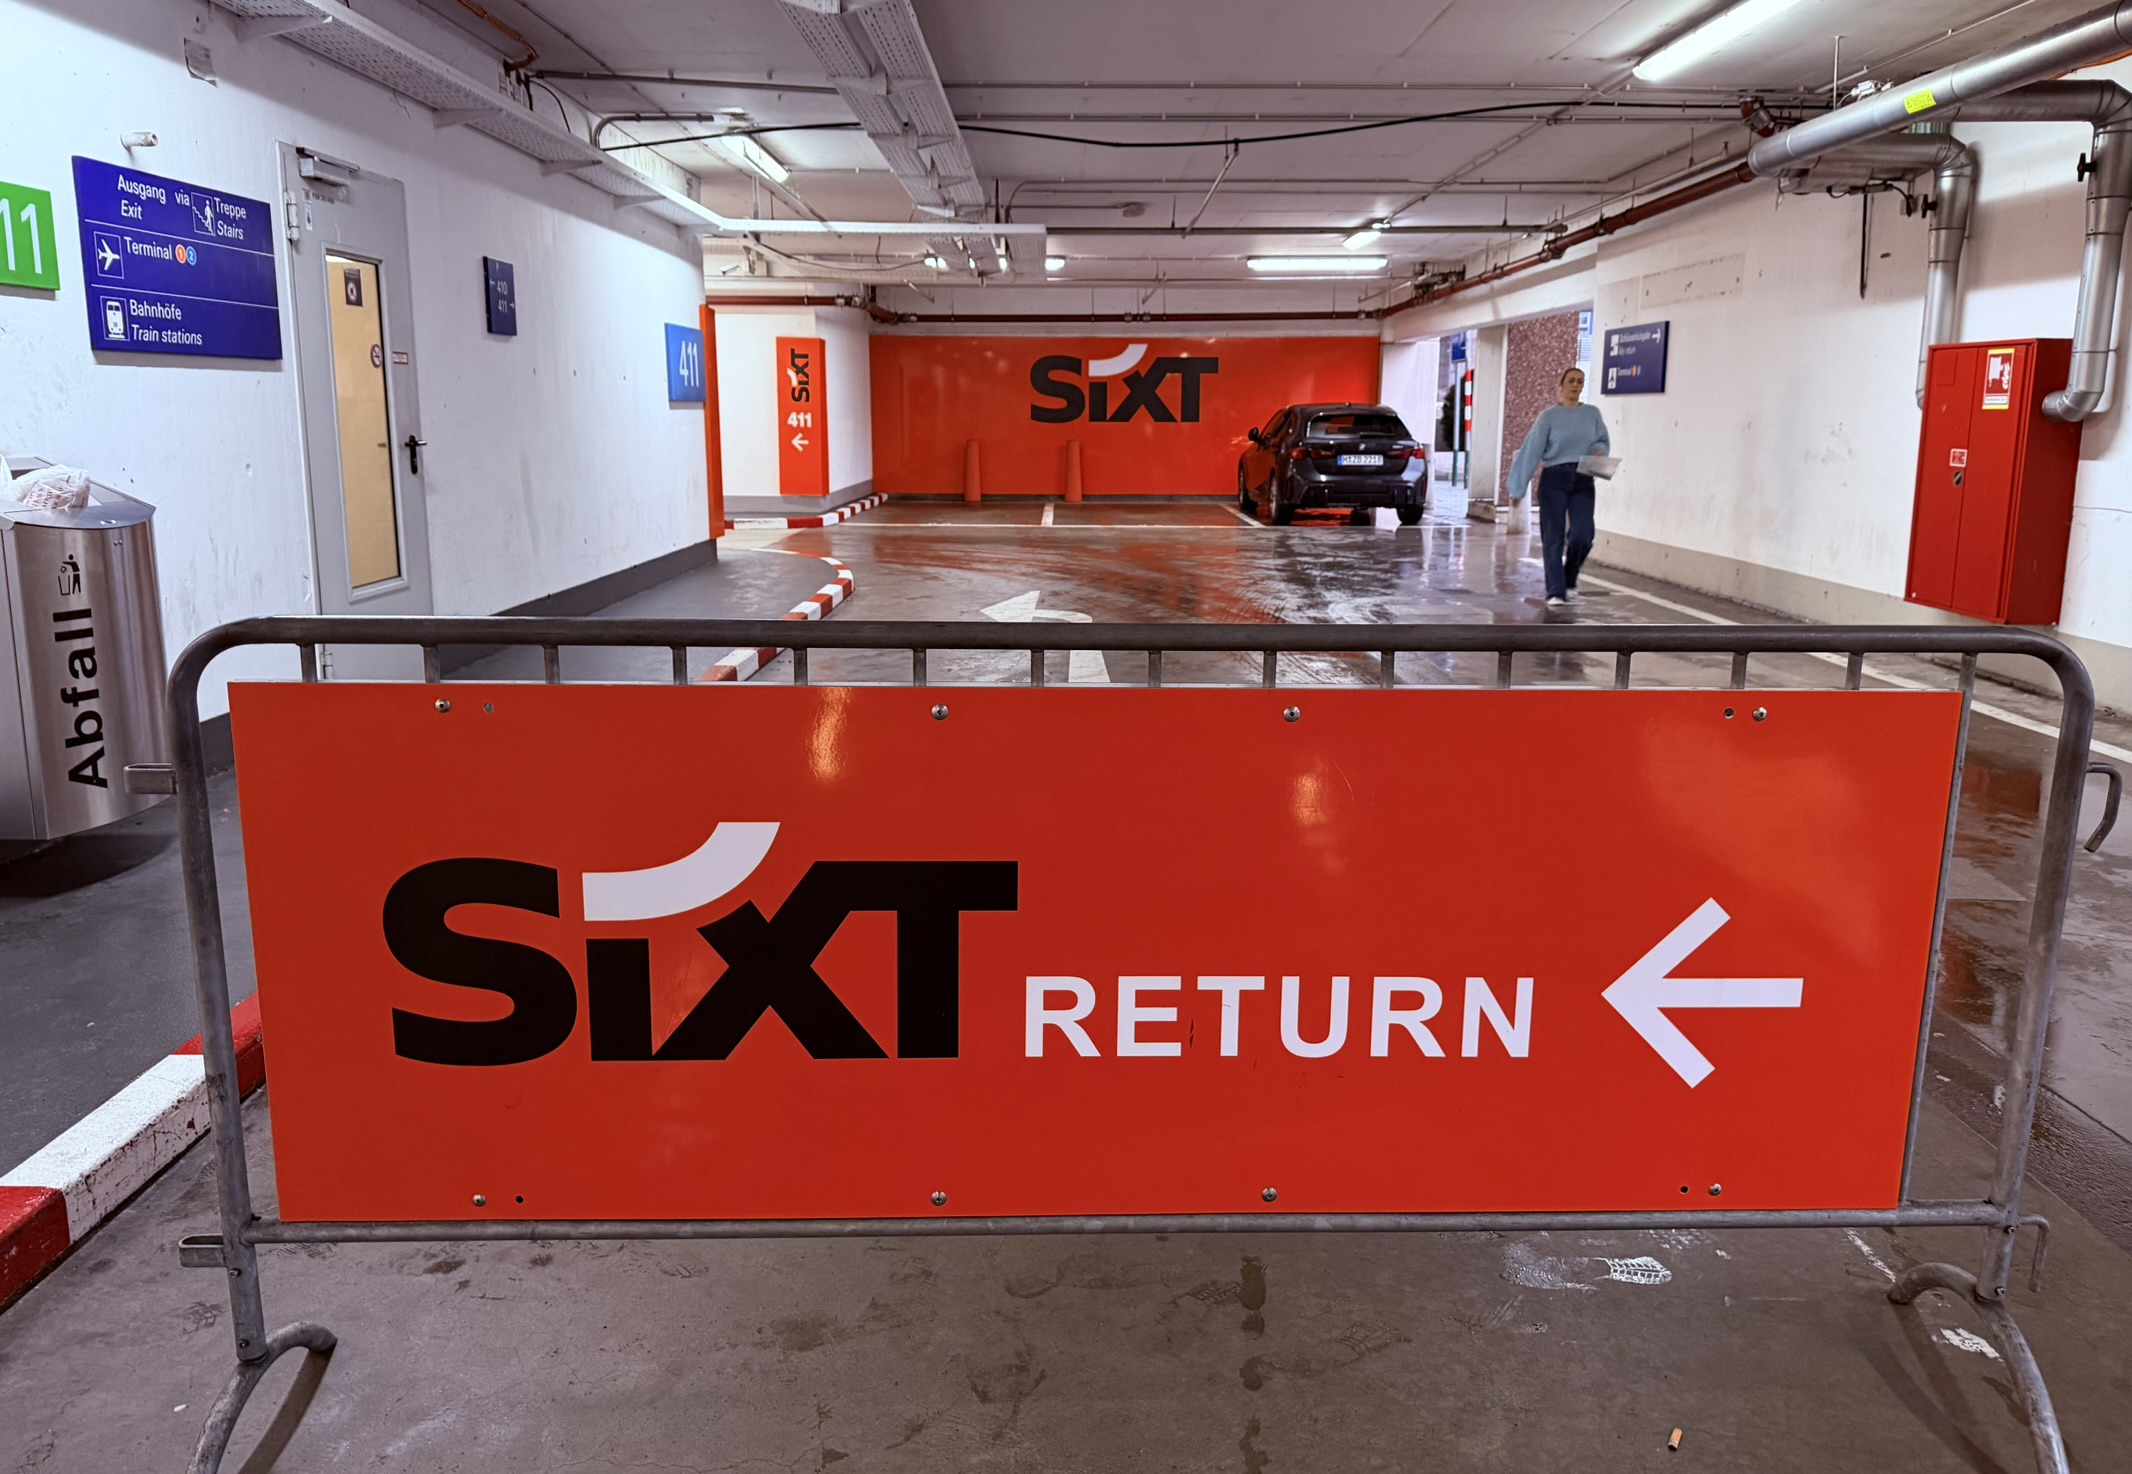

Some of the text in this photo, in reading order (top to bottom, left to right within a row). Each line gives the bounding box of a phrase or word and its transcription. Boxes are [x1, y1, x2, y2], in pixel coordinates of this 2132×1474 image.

[117, 174, 247, 220] Ausgang via Treppe
[121, 200, 143, 220] Exit
[217, 220, 244, 240] Stairs
[123, 236, 173, 260] Terminal
[129, 299, 182, 320] Bahnhöfe
[131, 323, 203, 345] Train stations
[679, 340, 699, 387] 411
[787, 411, 812, 428] 411
[52, 608, 108, 789] Abfall
[1025, 975, 1534, 1058] RETURN
